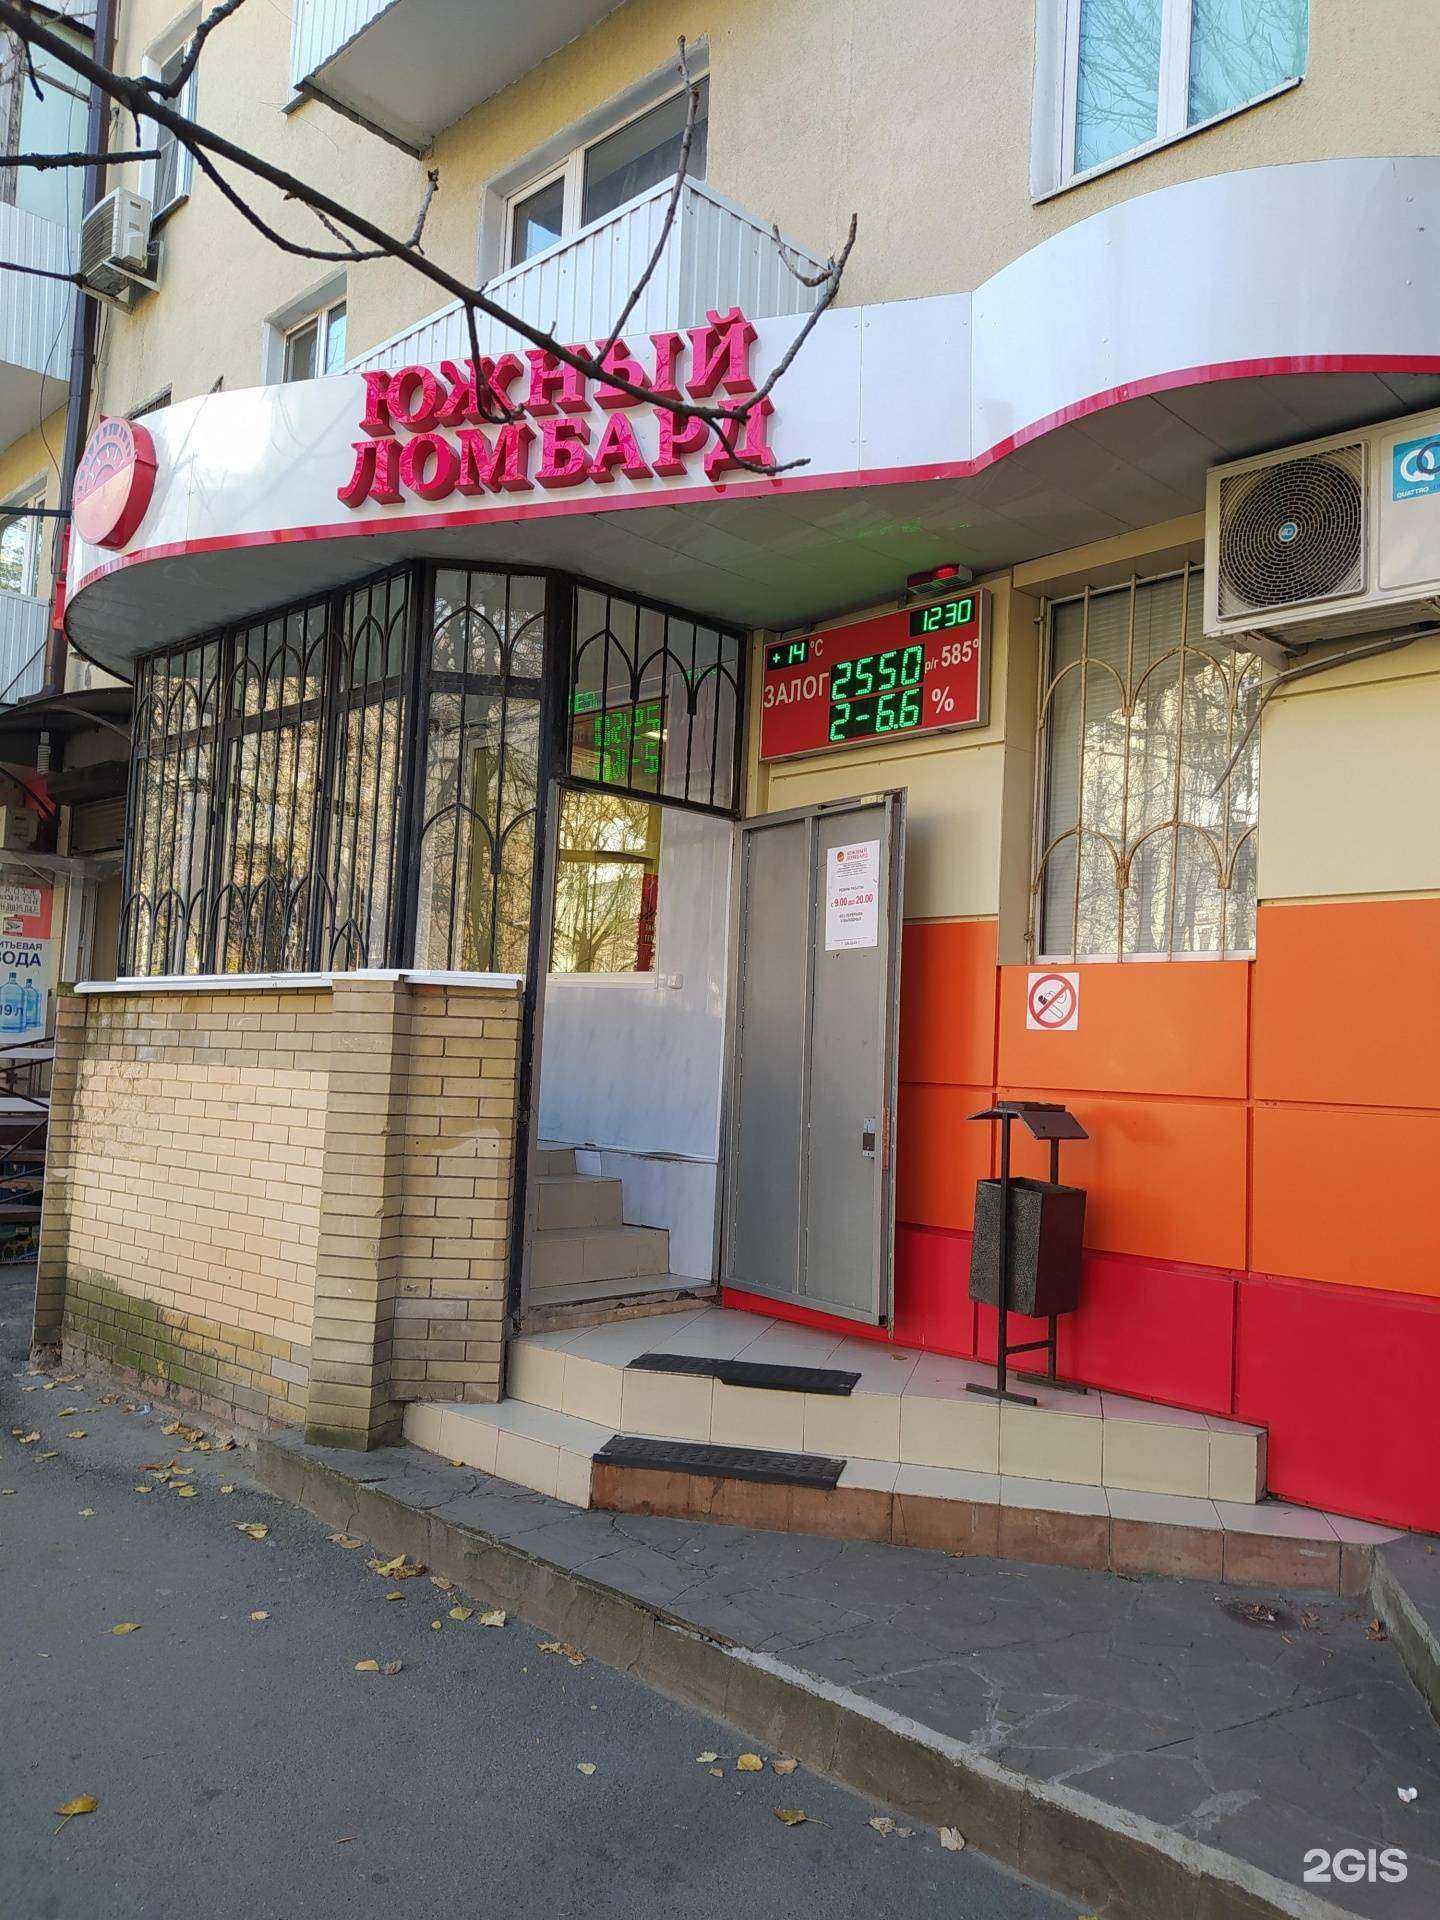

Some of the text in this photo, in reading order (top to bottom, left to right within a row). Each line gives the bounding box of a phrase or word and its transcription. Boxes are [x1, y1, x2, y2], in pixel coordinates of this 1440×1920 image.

[359, 306, 758, 437] ЮЖНЫЙ
[337, 394, 778, 508] ЛОМБАРД
[764, 672, 830, 708] ЗАЛОГ
[832, 645, 923, 702] 2550
[0, 950, 42, 968] ОДА
